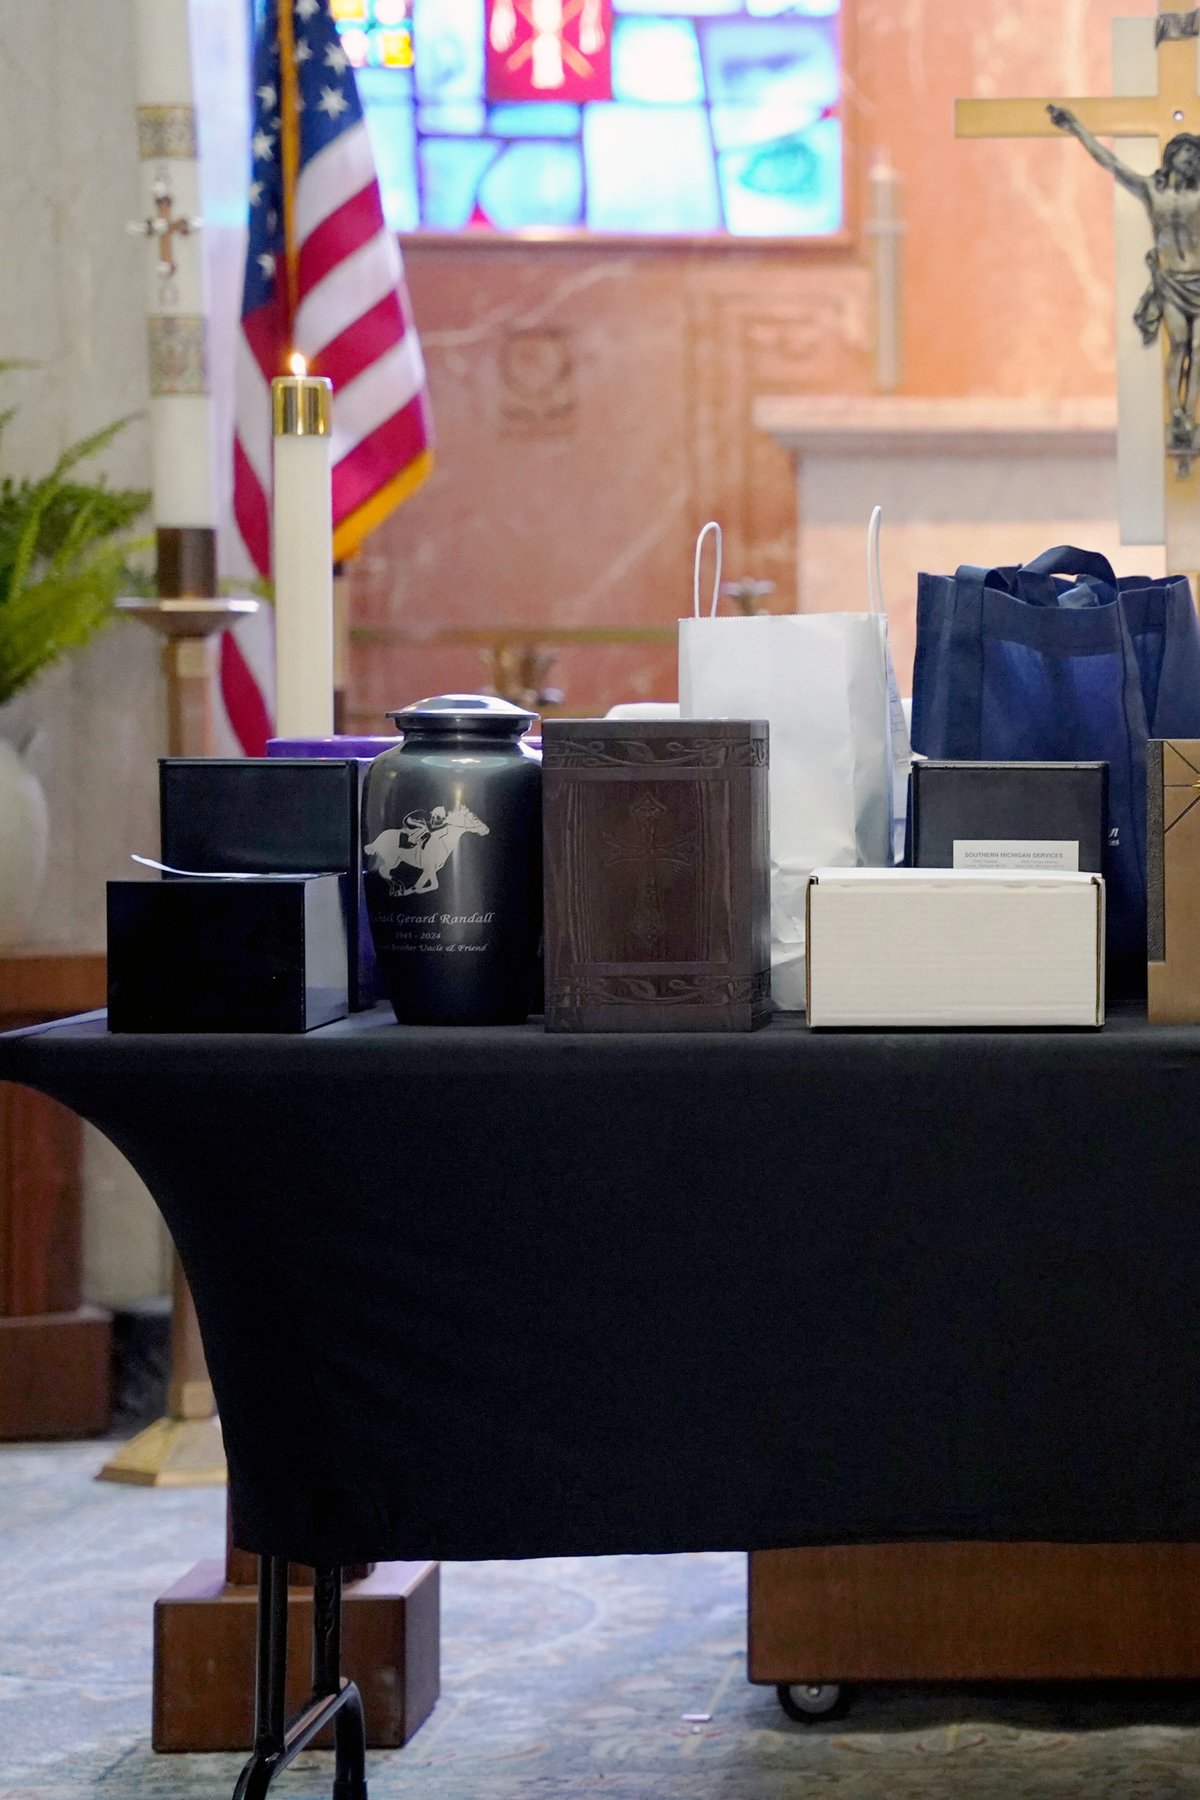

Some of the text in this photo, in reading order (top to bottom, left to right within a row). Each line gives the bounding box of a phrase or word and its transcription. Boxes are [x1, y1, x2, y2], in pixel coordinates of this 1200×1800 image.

[964, 851, 1064, 860] SOUTHERN MICHIGAN SERVICES
[396, 911, 439, 926] Gerard
[440, 911, 495, 925] Randall
[420, 931, 441, 940] 2024
[418, 943, 443, 952] Uncle
[457, 943, 488, 952] Friend
